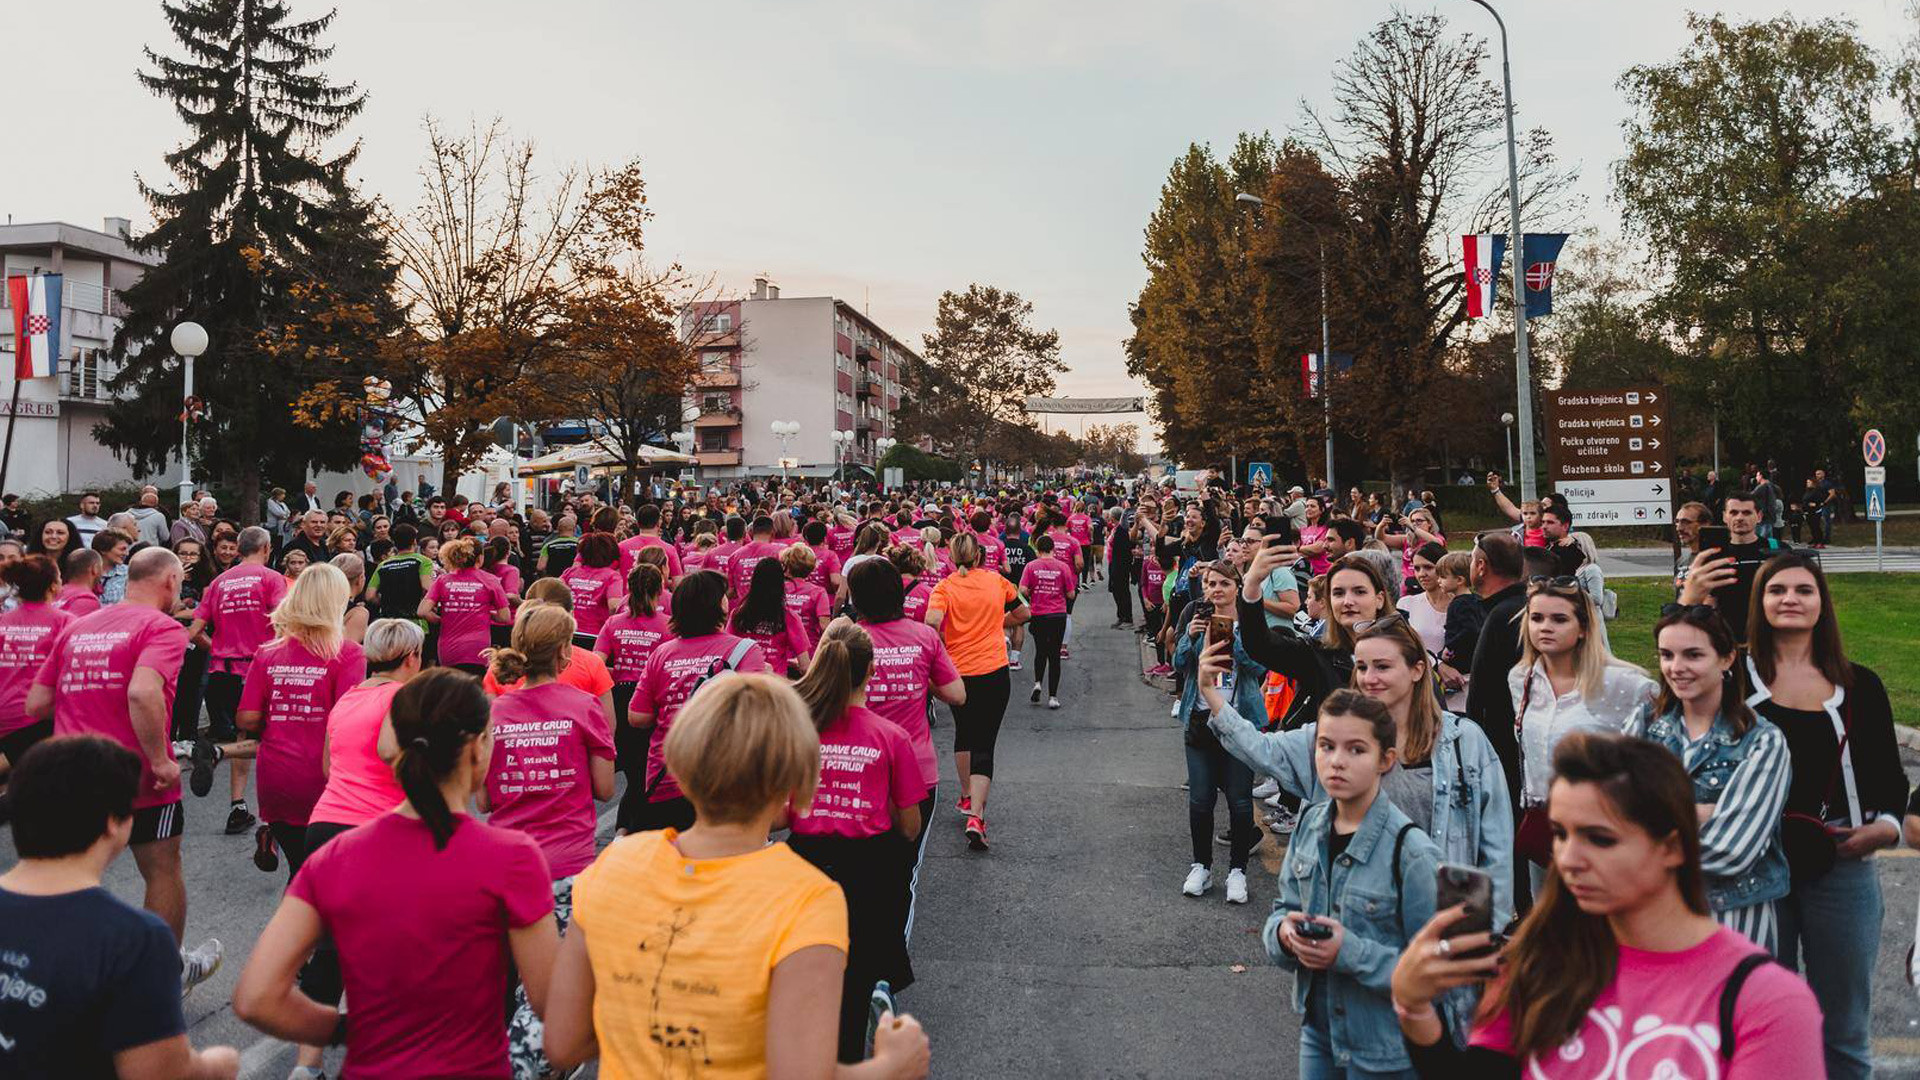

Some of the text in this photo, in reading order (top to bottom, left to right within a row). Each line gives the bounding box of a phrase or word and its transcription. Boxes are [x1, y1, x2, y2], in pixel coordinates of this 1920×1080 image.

[1558, 394, 1623, 406] Gradska knjižnica
[0, 402, 54, 414] AGREB
[1558, 418, 1590, 428] Gradska
[1560, 437, 1620, 446] Pučko otvoreno
[1578, 446, 1608, 455] učilište
[1562, 463, 1625, 474] Glazbena škola
[1564, 488, 1595, 498] Policija
[275, 666, 305, 674] ZDRAVE
[306, 666, 328, 676] GRUDI
[284, 678, 315, 686] POTRUDI
[502, 722, 541, 734] ZDRAVE
[542, 720, 572, 731] GRUDI
[504, 737, 558, 748] SE POTRUDI
[820, 744, 882, 758] DRAVE GRUDI
[826, 760, 865, 772] POTRUDI
